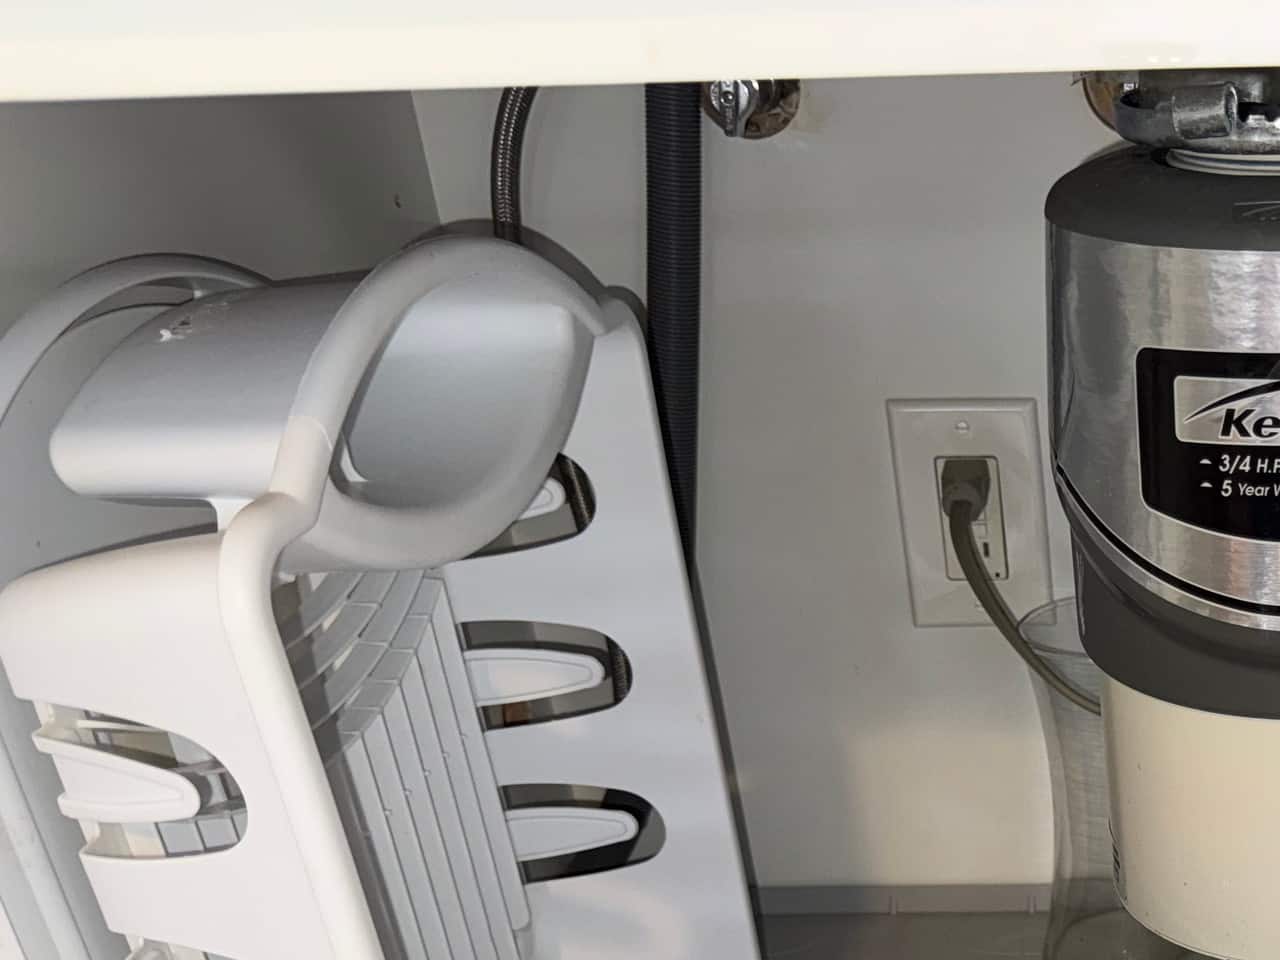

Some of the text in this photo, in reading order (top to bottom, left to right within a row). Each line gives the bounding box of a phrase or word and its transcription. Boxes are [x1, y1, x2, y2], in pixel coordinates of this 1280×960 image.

[1218, 454, 1251, 473] 3/4
[1220, 480, 1232, 497] 5
[1237, 483, 1270, 498] Year
